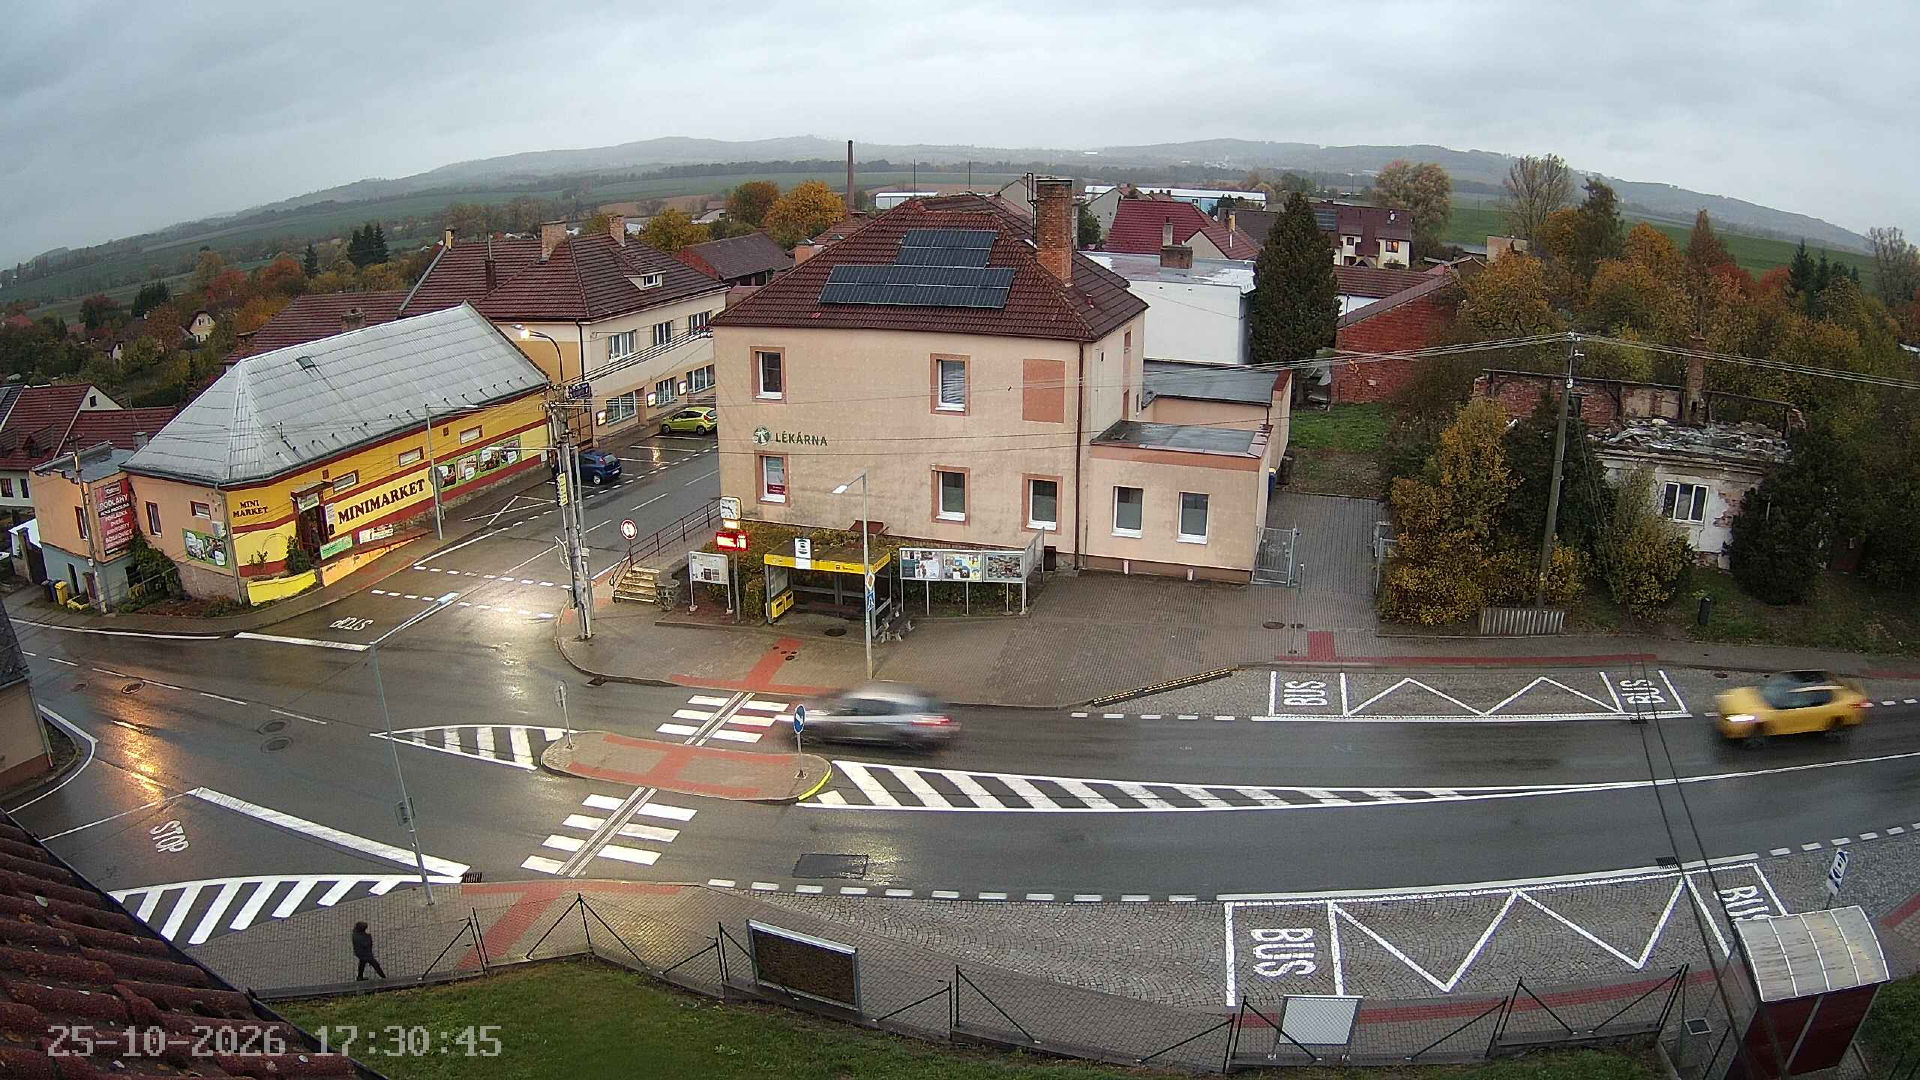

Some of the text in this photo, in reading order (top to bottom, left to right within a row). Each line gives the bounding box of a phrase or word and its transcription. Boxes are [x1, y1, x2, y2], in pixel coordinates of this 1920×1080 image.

[775, 431, 828, 446] LÉKÁRNA
[232, 506, 269, 518] MARKET
[240, 500, 260, 509] MINI
[337, 478, 425, 524] MINIMARKET
[329, 616, 374, 630] STOP
[1283, 680, 1328, 706] BUS
[1619, 679, 1667, 704] BUS
[149, 820, 189, 852] STOP
[1250, 927, 1317, 977] BUS
